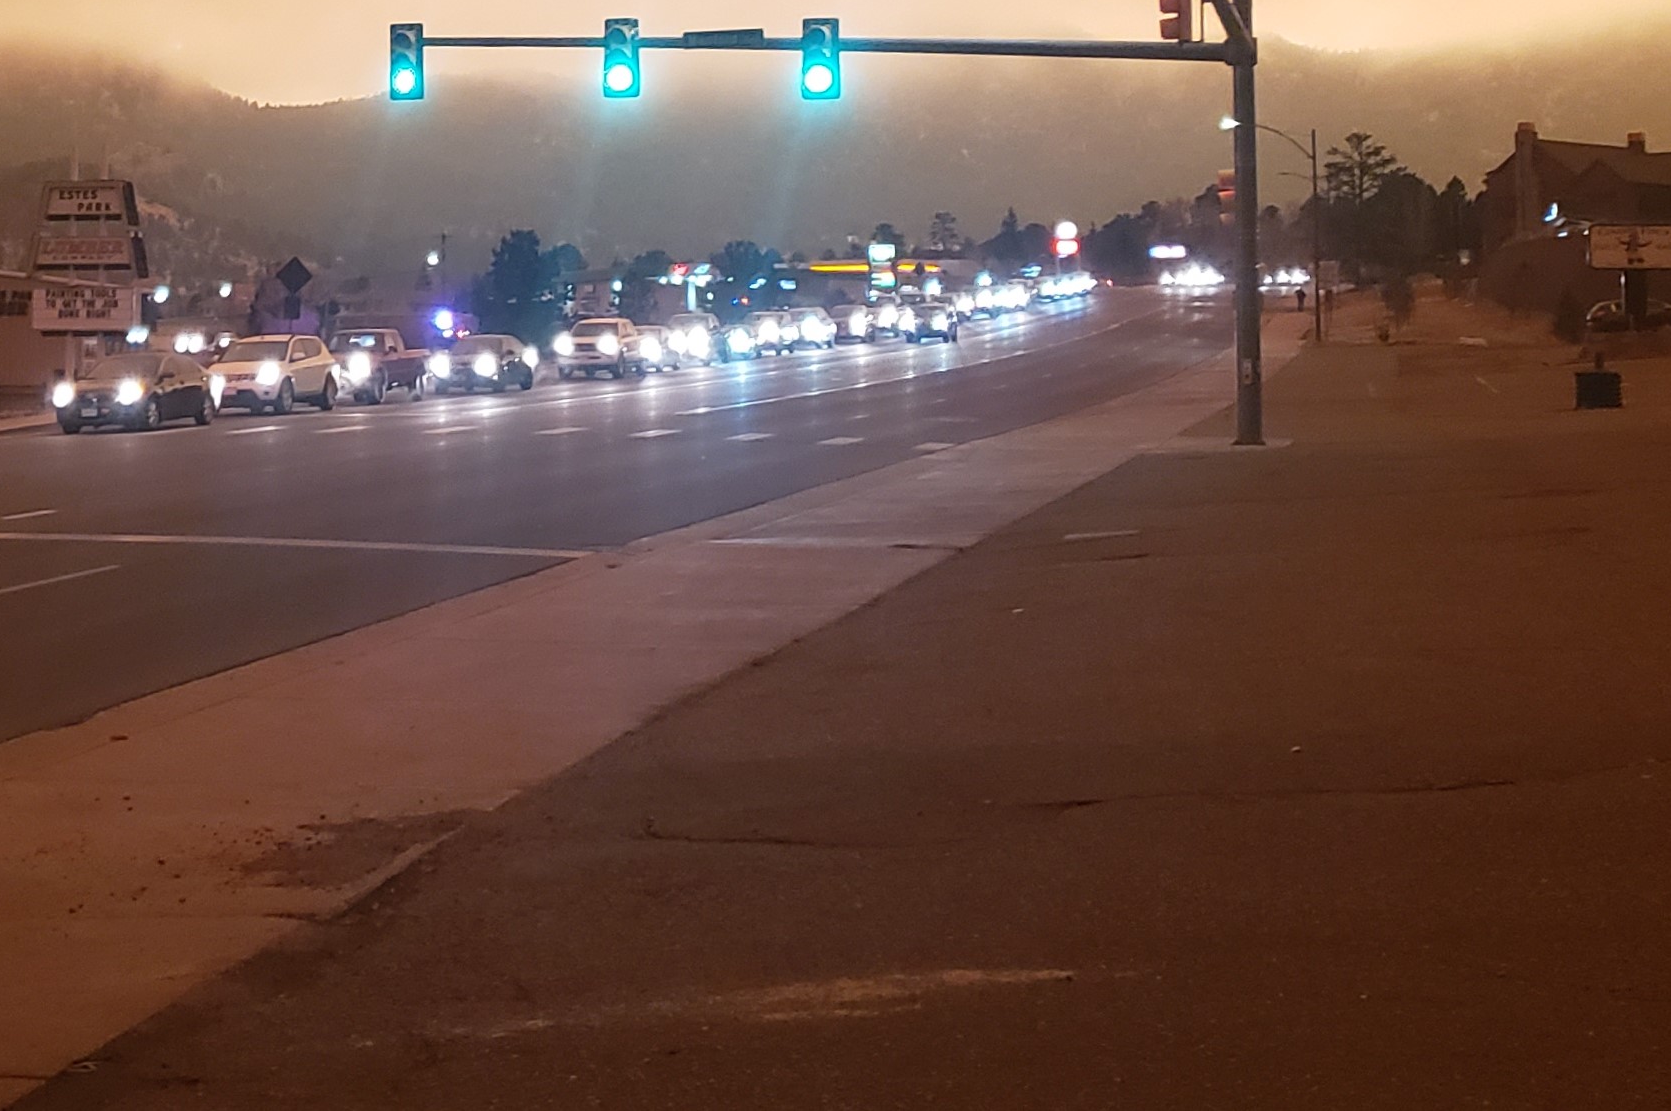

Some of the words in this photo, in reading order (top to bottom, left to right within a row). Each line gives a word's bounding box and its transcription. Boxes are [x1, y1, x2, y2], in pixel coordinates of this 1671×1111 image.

[58, 190, 98, 200] ESTES
[77, 202, 113, 212] PARK
[45, 299, 56, 308] TO
